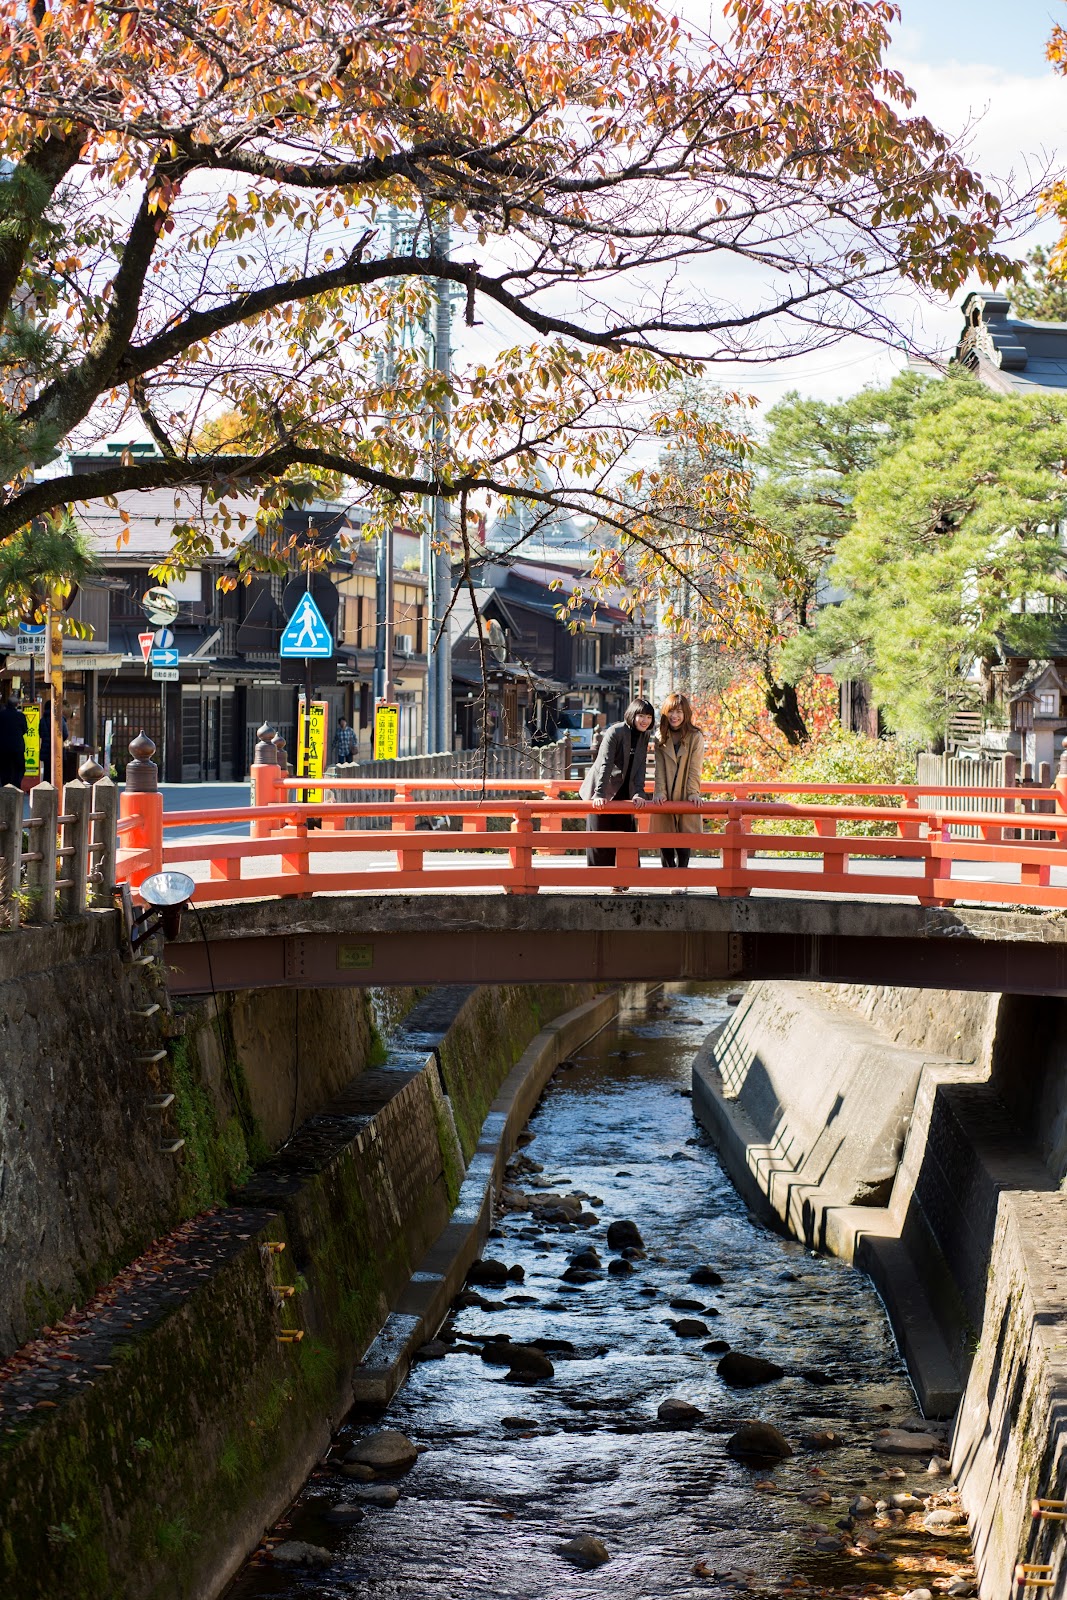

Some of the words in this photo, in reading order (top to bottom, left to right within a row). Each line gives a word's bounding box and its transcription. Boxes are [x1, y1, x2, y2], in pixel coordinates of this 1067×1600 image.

[25, 727, 36, 757] 徐行
[387, 715, 395, 753] 工事中につき
